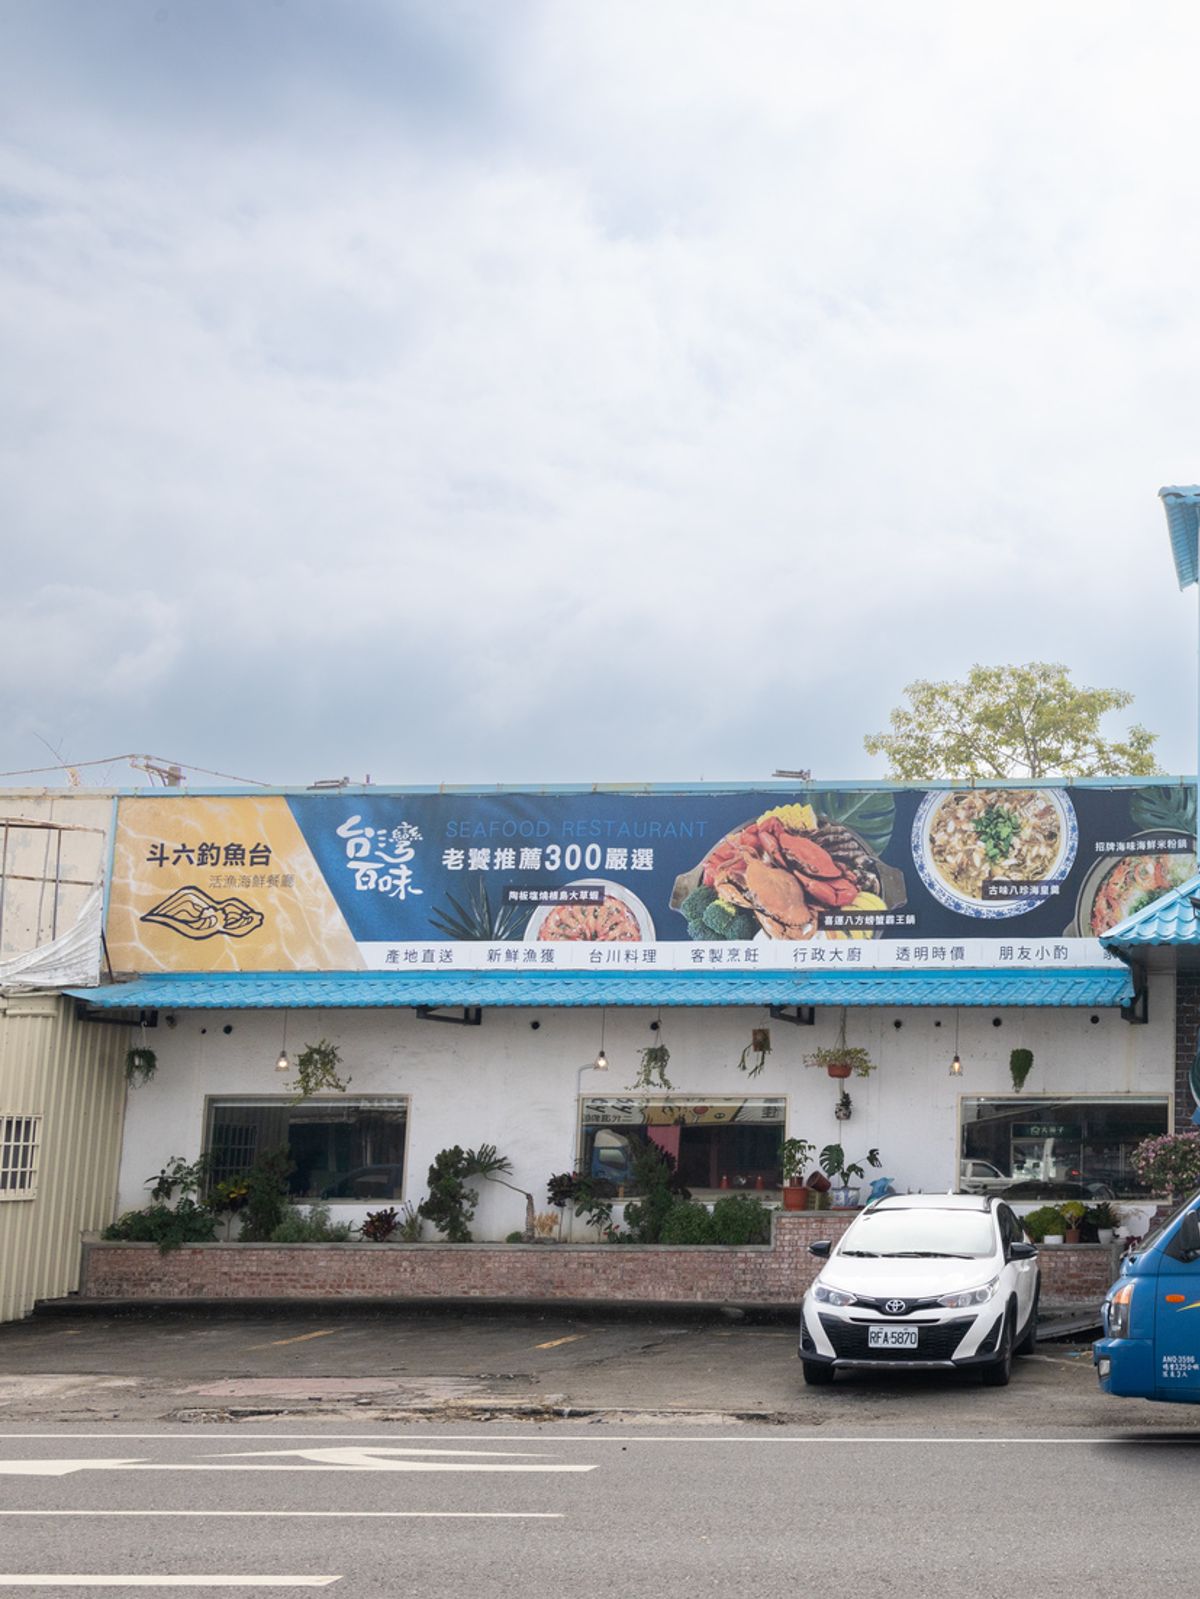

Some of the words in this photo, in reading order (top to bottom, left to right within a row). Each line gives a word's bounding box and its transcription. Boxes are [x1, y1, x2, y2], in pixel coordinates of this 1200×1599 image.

[445, 821, 552, 838] SEAFOOD
[562, 820, 709, 838] RESTAURANT
[336, 815, 423, 863] 台灣
[146, 842, 272, 867] 斗六釣魚台
[441, 843, 654, 872] 老饕推薦300嚴選
[346, 860, 423, 900] 百味
[385, 949, 454, 964] 產地直送
[486, 948, 556, 964] 新鮮漁獲
[589, 948, 658, 964] 台川料理
[690, 948, 760, 964] 客製烹飪
[793, 946, 862, 963] 行政大廚
[896, 946, 967, 962] 透明時價
[999, 945, 1069, 961] 朋友小酌
